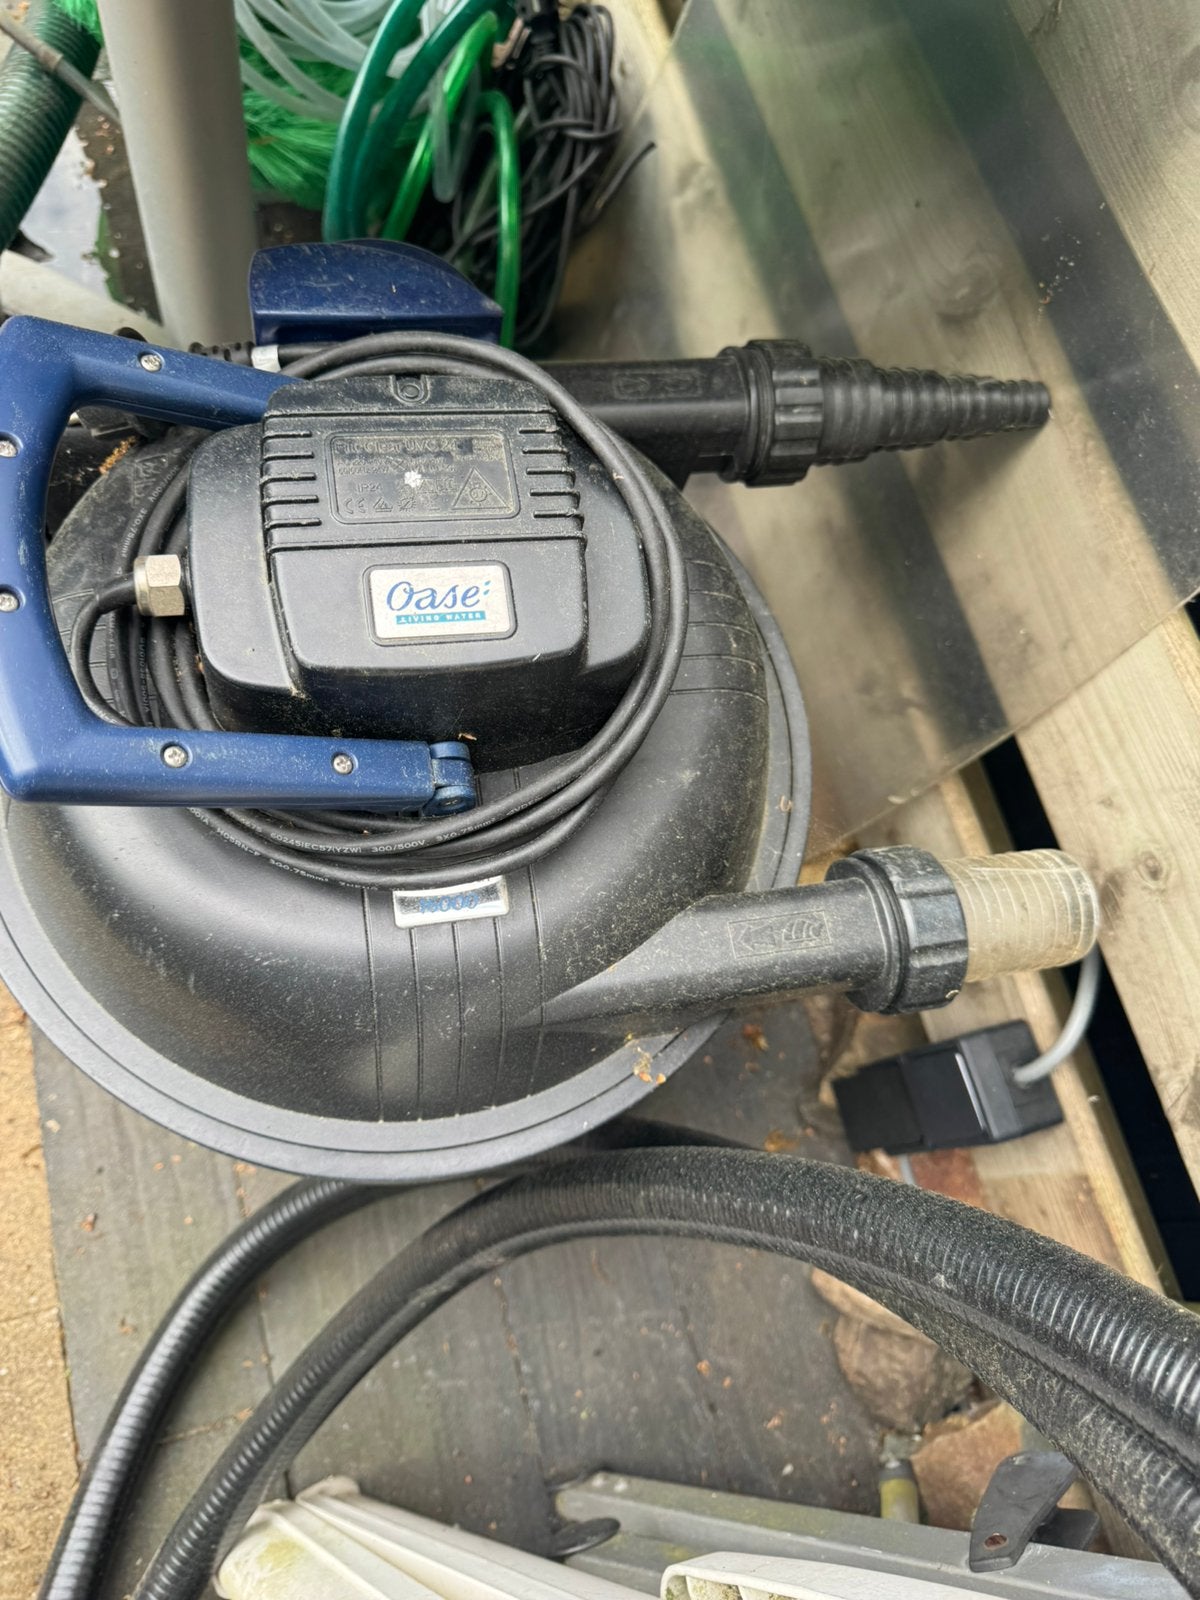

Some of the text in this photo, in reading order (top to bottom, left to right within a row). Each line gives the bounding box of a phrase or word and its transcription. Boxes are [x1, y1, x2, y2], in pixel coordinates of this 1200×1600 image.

[399, 611, 482, 624] LIVING WATER
[371, 839, 426, 853] 300/500V
